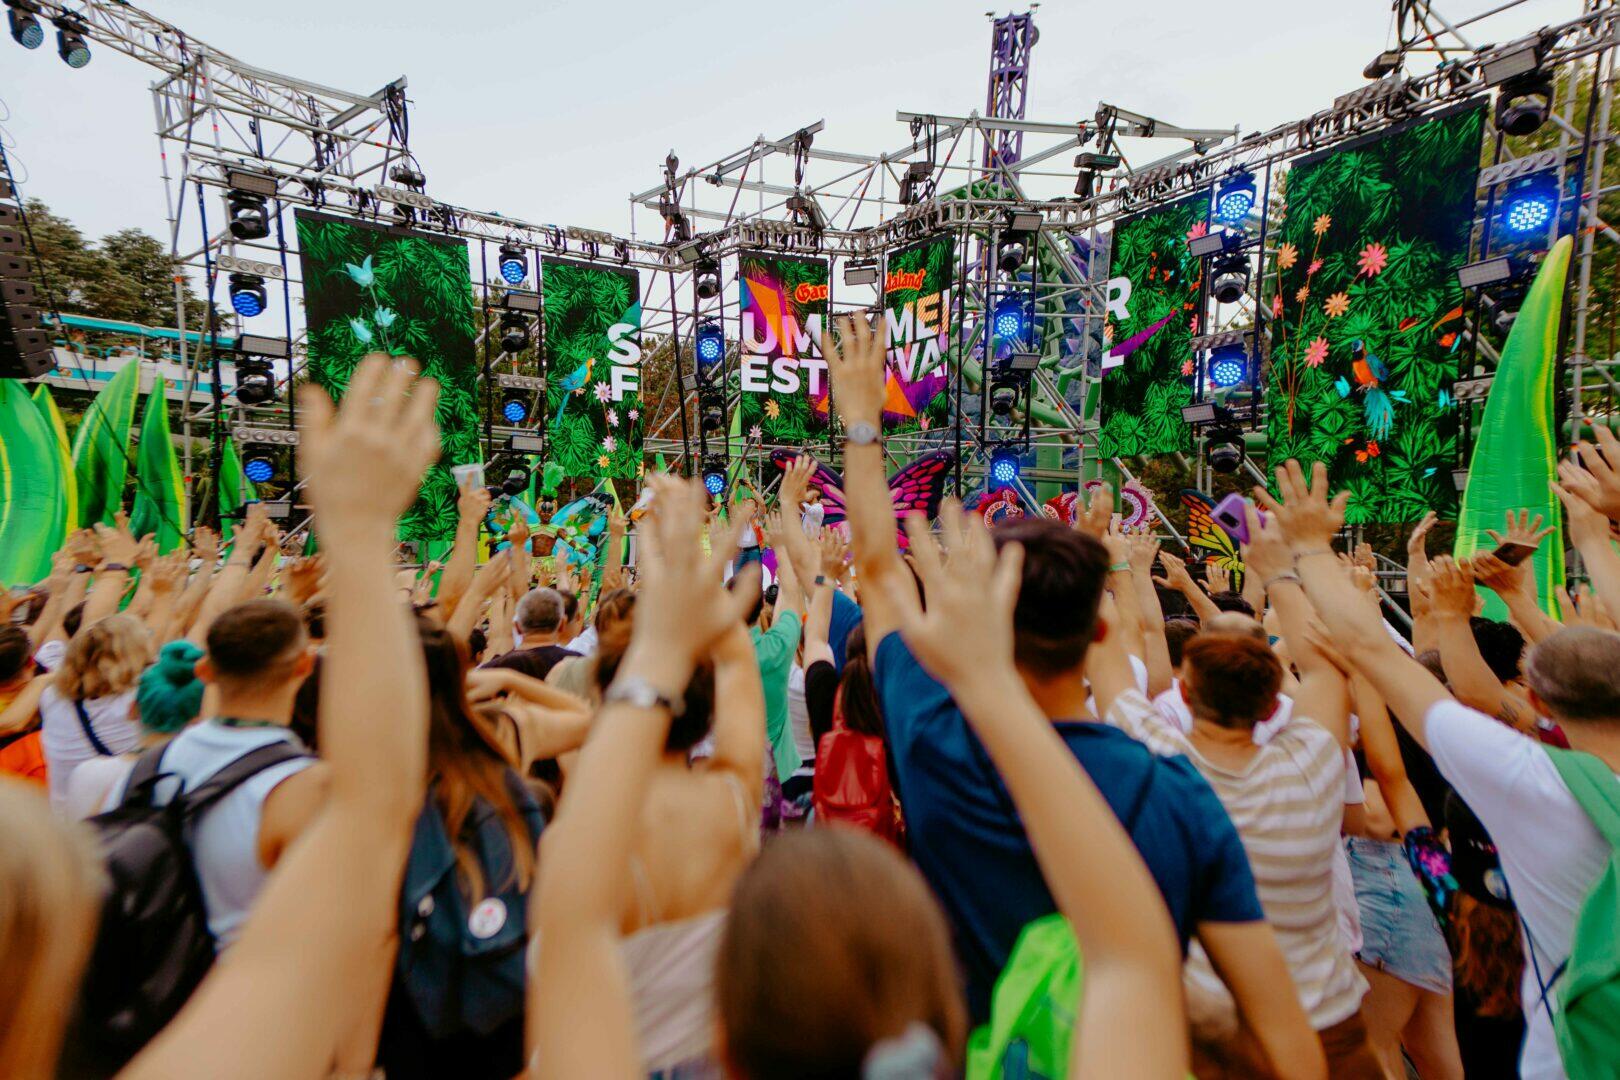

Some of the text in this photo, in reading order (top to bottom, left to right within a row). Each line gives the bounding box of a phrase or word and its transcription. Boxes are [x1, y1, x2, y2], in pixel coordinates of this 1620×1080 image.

[607, 322, 641, 366] S
[610, 365, 639, 402] F
[740, 354, 829, 396] EST
